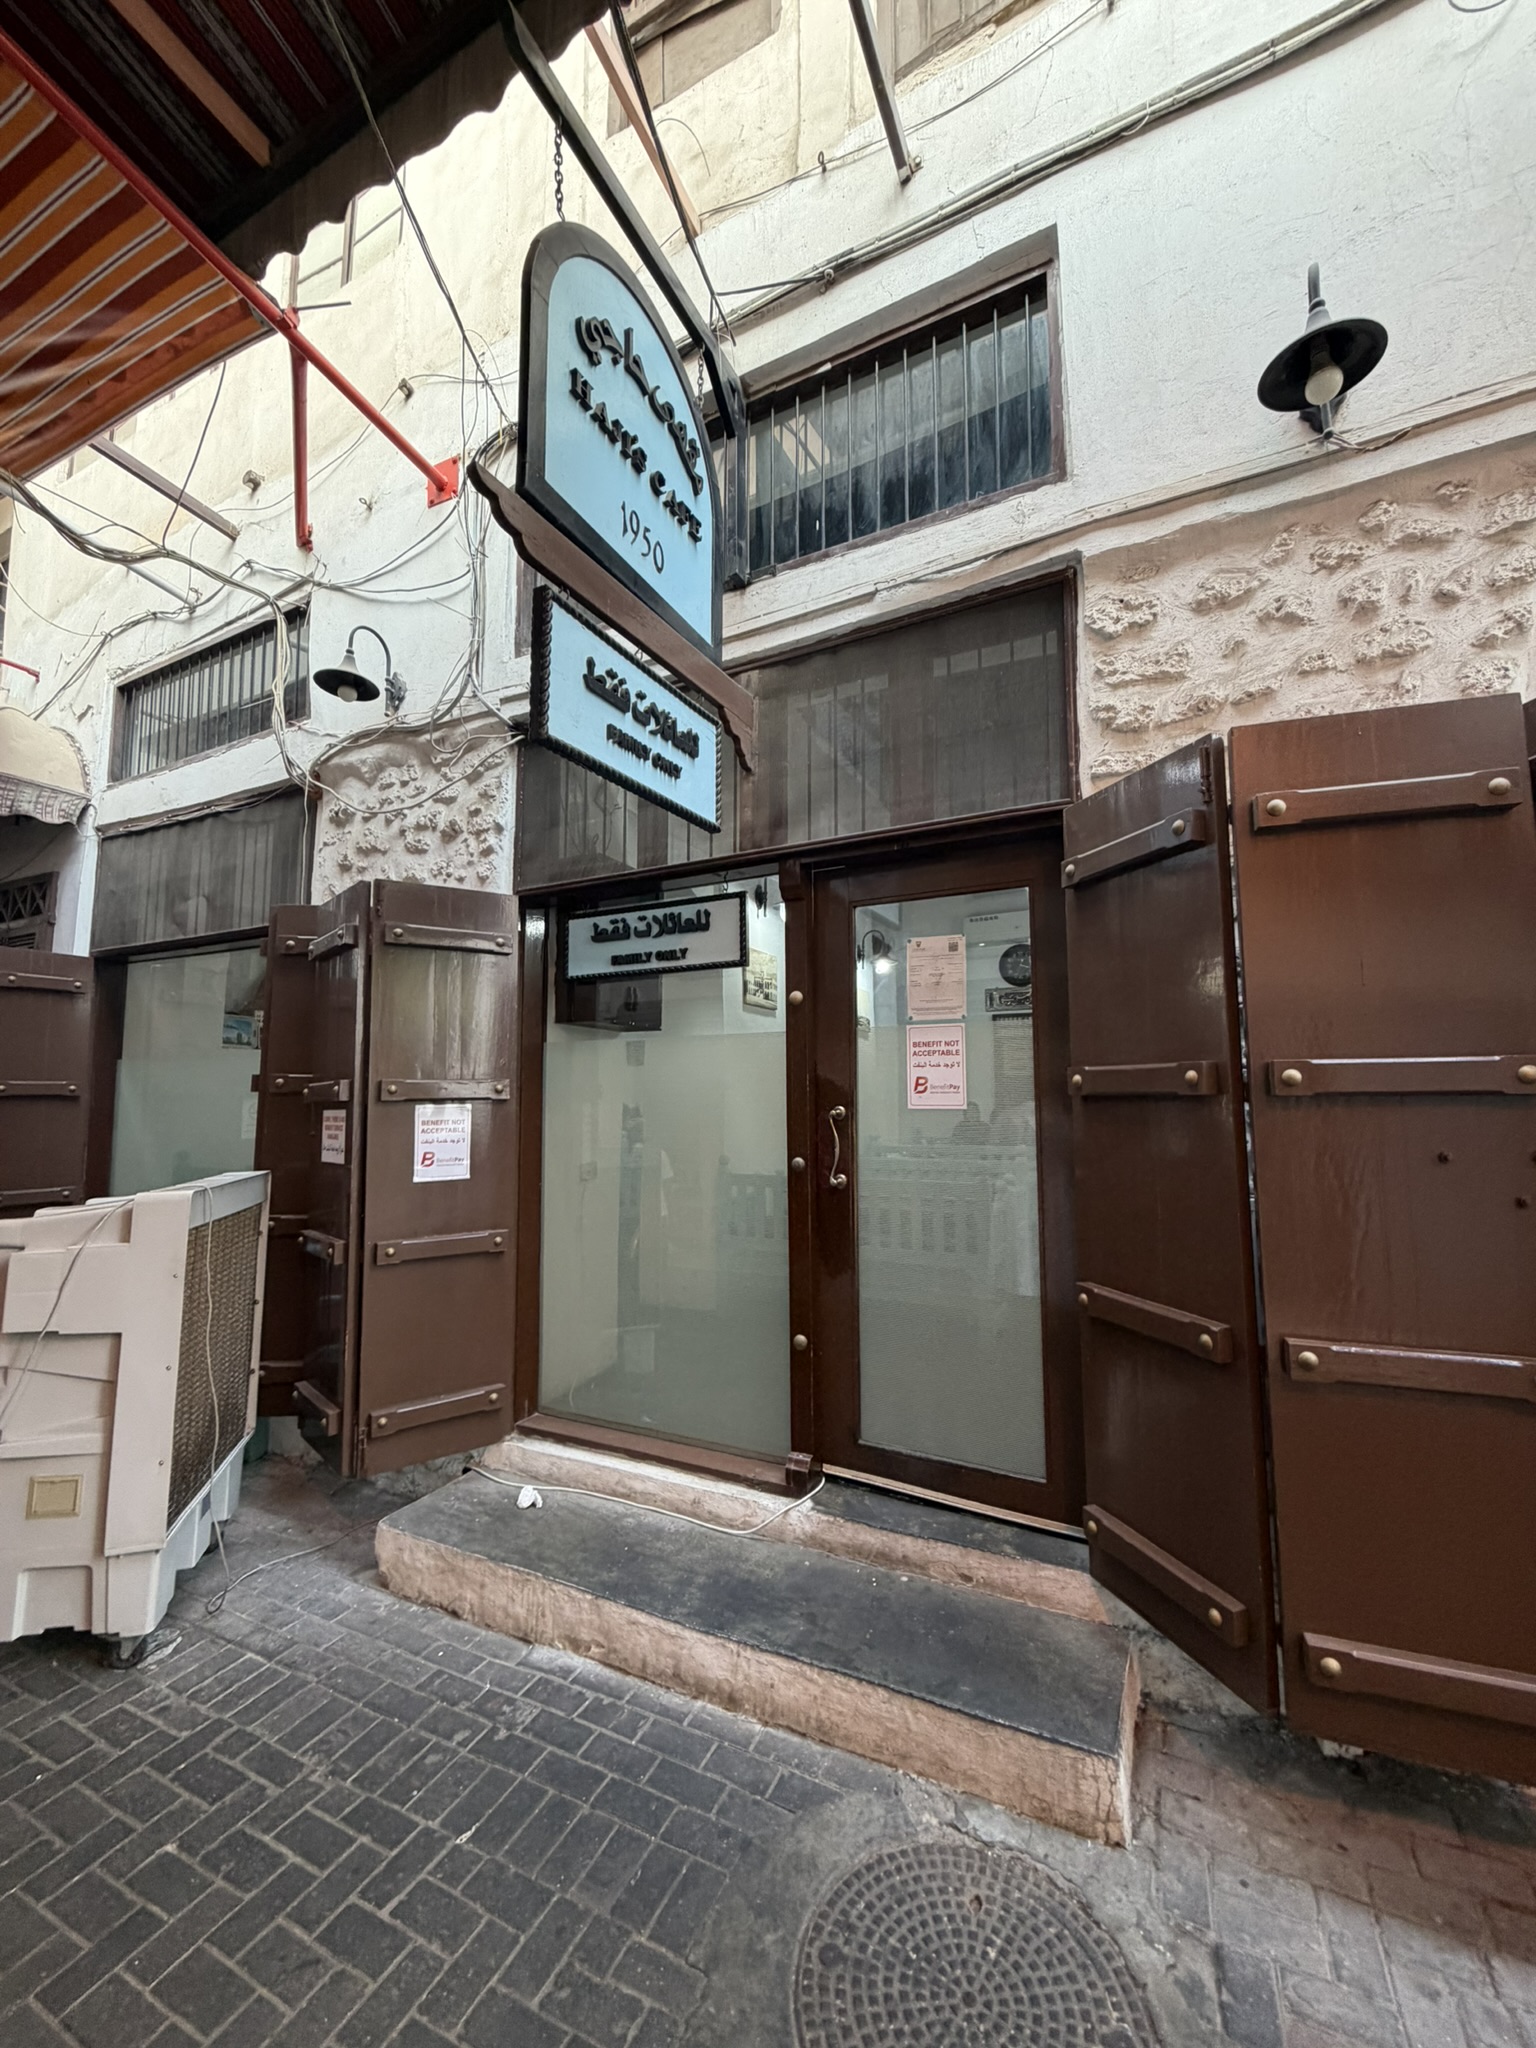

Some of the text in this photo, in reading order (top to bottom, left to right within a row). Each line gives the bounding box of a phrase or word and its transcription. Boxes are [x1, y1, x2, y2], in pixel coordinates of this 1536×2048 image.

[574, 316, 649, 396] حاجي
[569, 367, 703, 544] HAJI'S CAFE
[620, 500, 665, 574] 1950
[582, 656, 700, 760] للعائلات فقط
[606, 723, 683, 780] FAMILY ONLY
[590, 908, 712, 943] للعائلات فقط
[610, 947, 689, 966] FAMILY ONLY
[912, 1039, 960, 1048] BENEFIT NOT
[912, 1049, 960, 1057] ACCEPTABLE
[420, 1127, 466, 1135] ACCEPTABLE
[421, 1119, 450, 1127] BENEFIT
